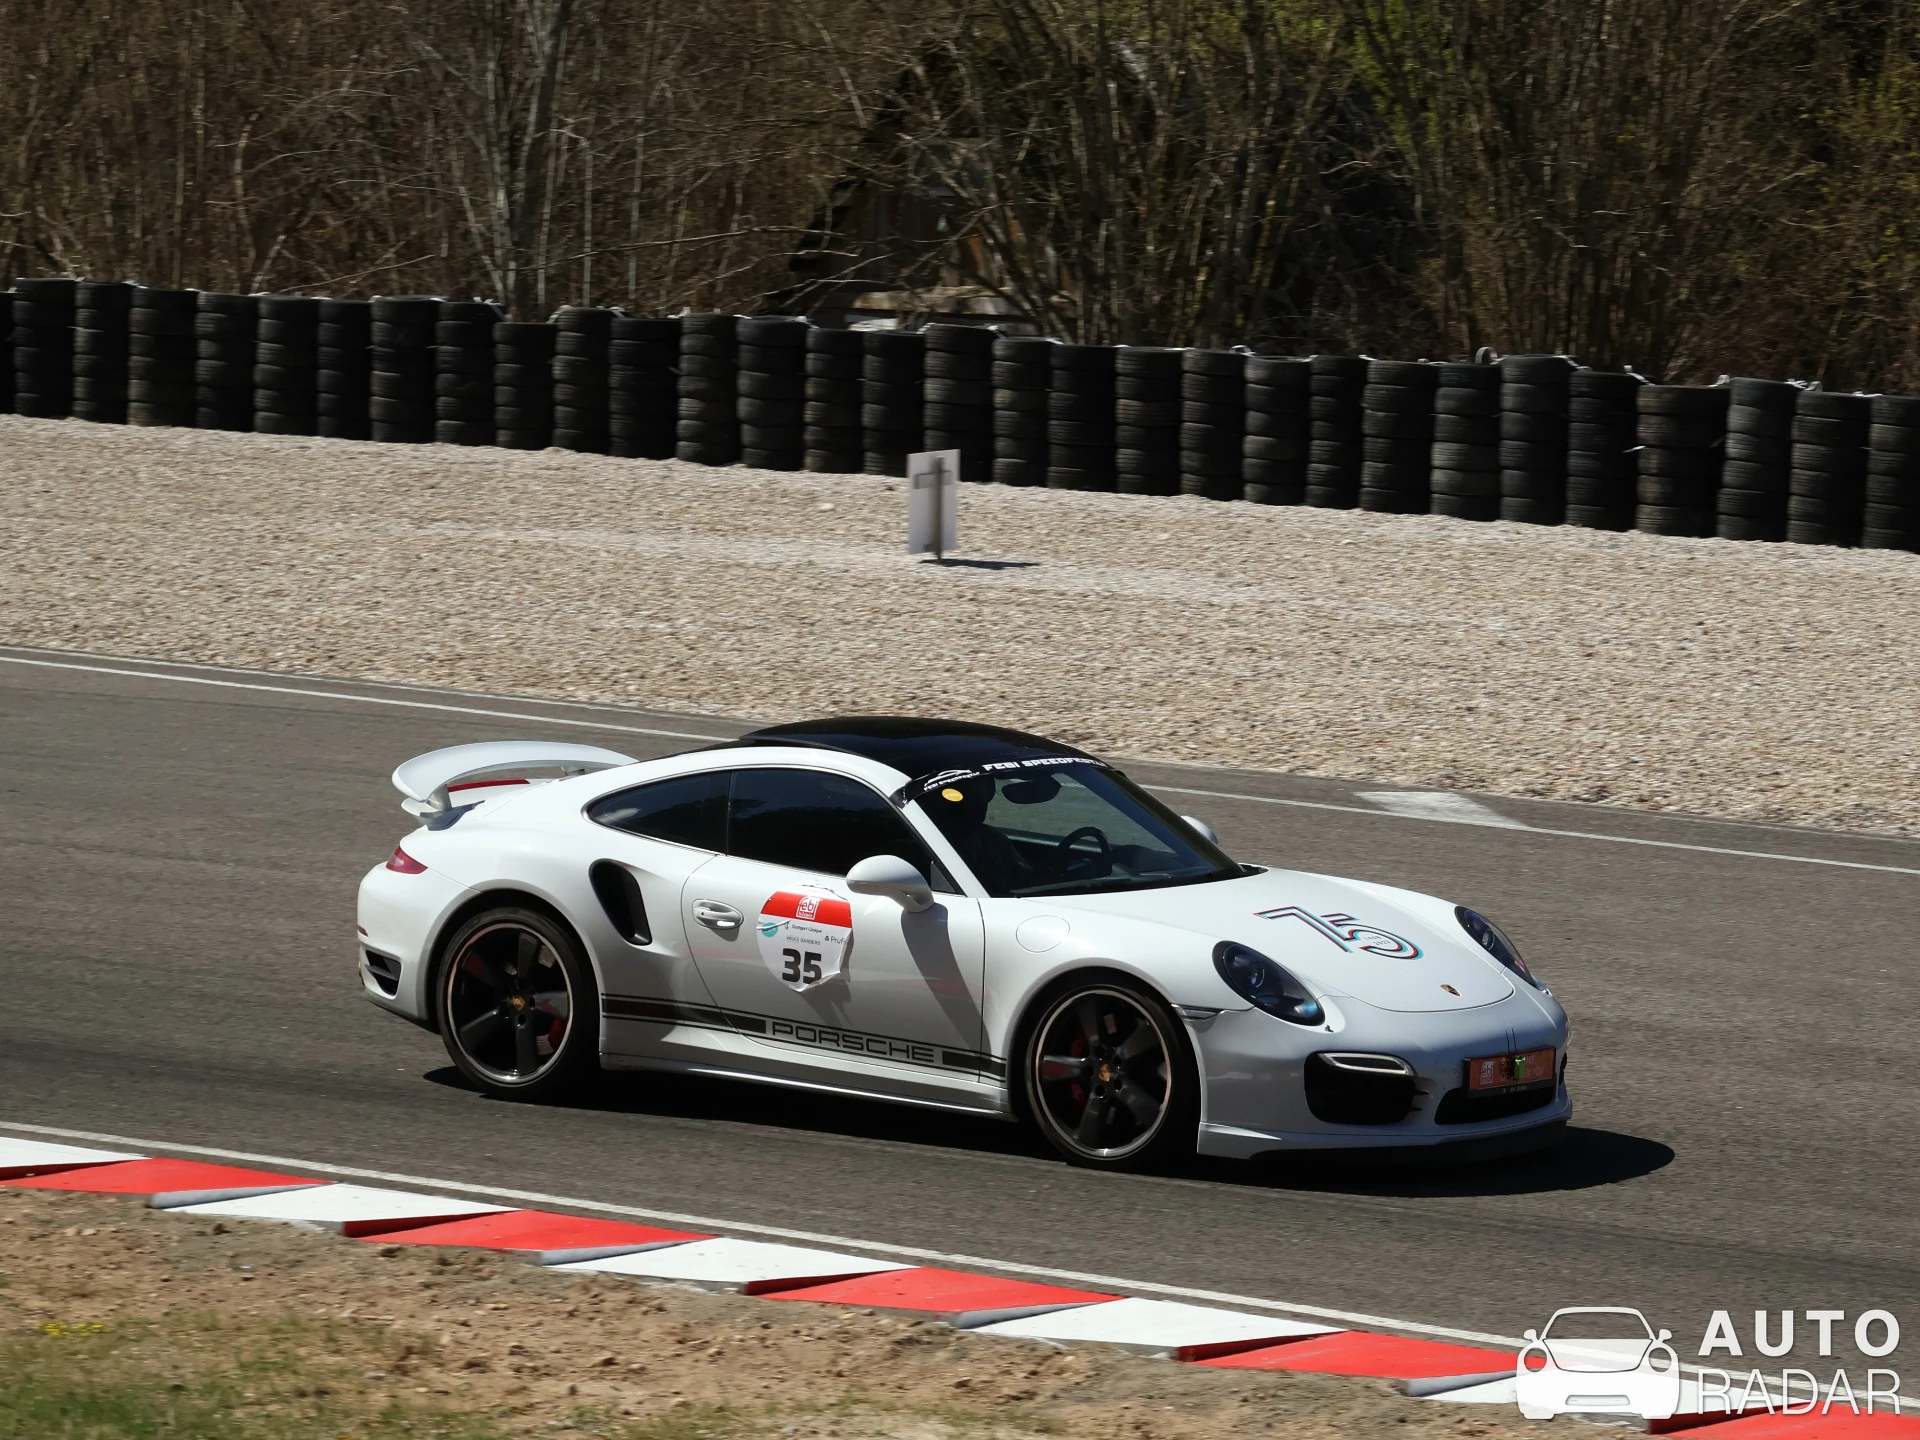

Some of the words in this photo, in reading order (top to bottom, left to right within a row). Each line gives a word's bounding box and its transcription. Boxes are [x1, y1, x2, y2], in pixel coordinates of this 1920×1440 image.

[982, 761, 1020, 772] FEBI
[782, 948, 822, 985] 35
[771, 1023, 935, 1063] PORSCHE
